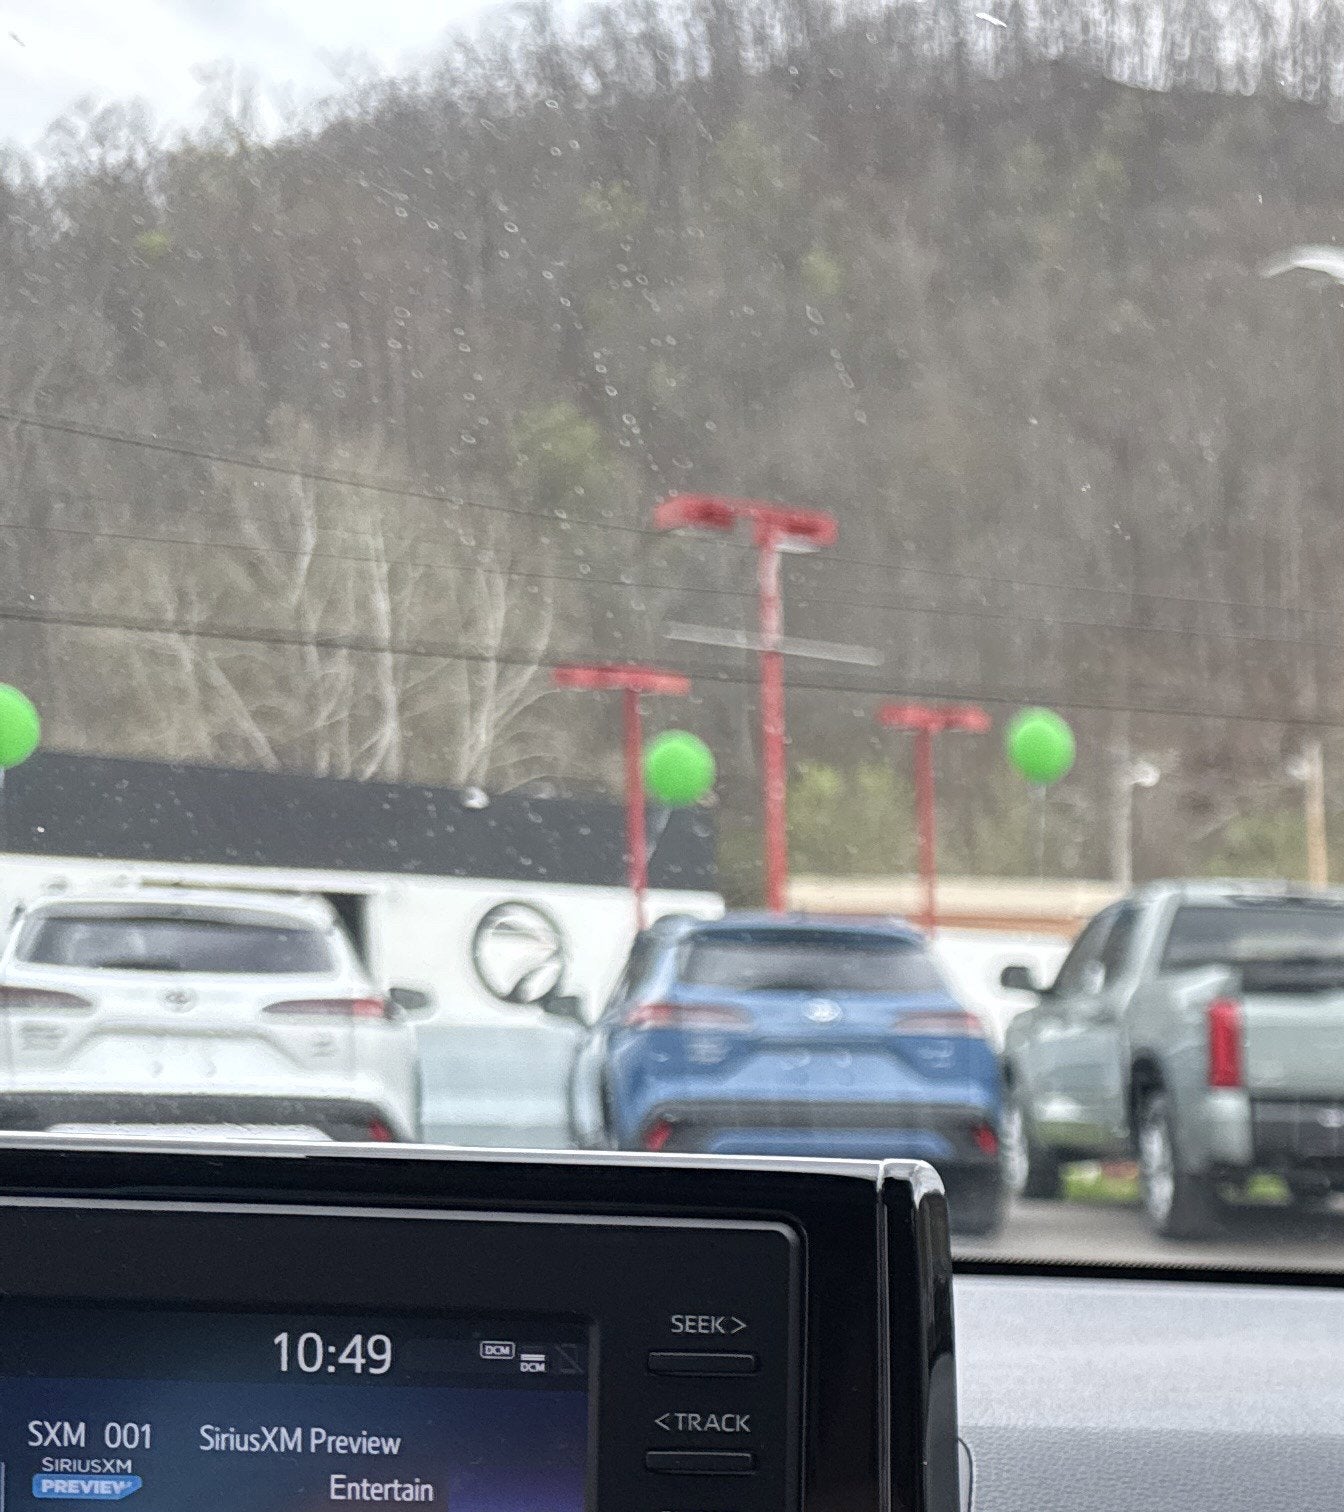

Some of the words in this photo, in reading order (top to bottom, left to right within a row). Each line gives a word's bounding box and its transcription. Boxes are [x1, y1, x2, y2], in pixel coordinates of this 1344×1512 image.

[671, 1314, 726, 1334] SEEK
[273, 1331, 392, 1374] 10:49
[485, 1345, 510, 1355] DCM
[520, 1362, 546, 1372] DCM
[674, 1413, 751, 1433] TRACK
[28, 1420, 86, 1448] SXM
[104, 1422, 151, 1449] 001
[200, 1424, 301, 1453] SiriusXM
[310, 1428, 401, 1455] Preview
[41, 1456, 133, 1473] SIRIUSXM
[330, 1474, 434, 1502] Entertain
